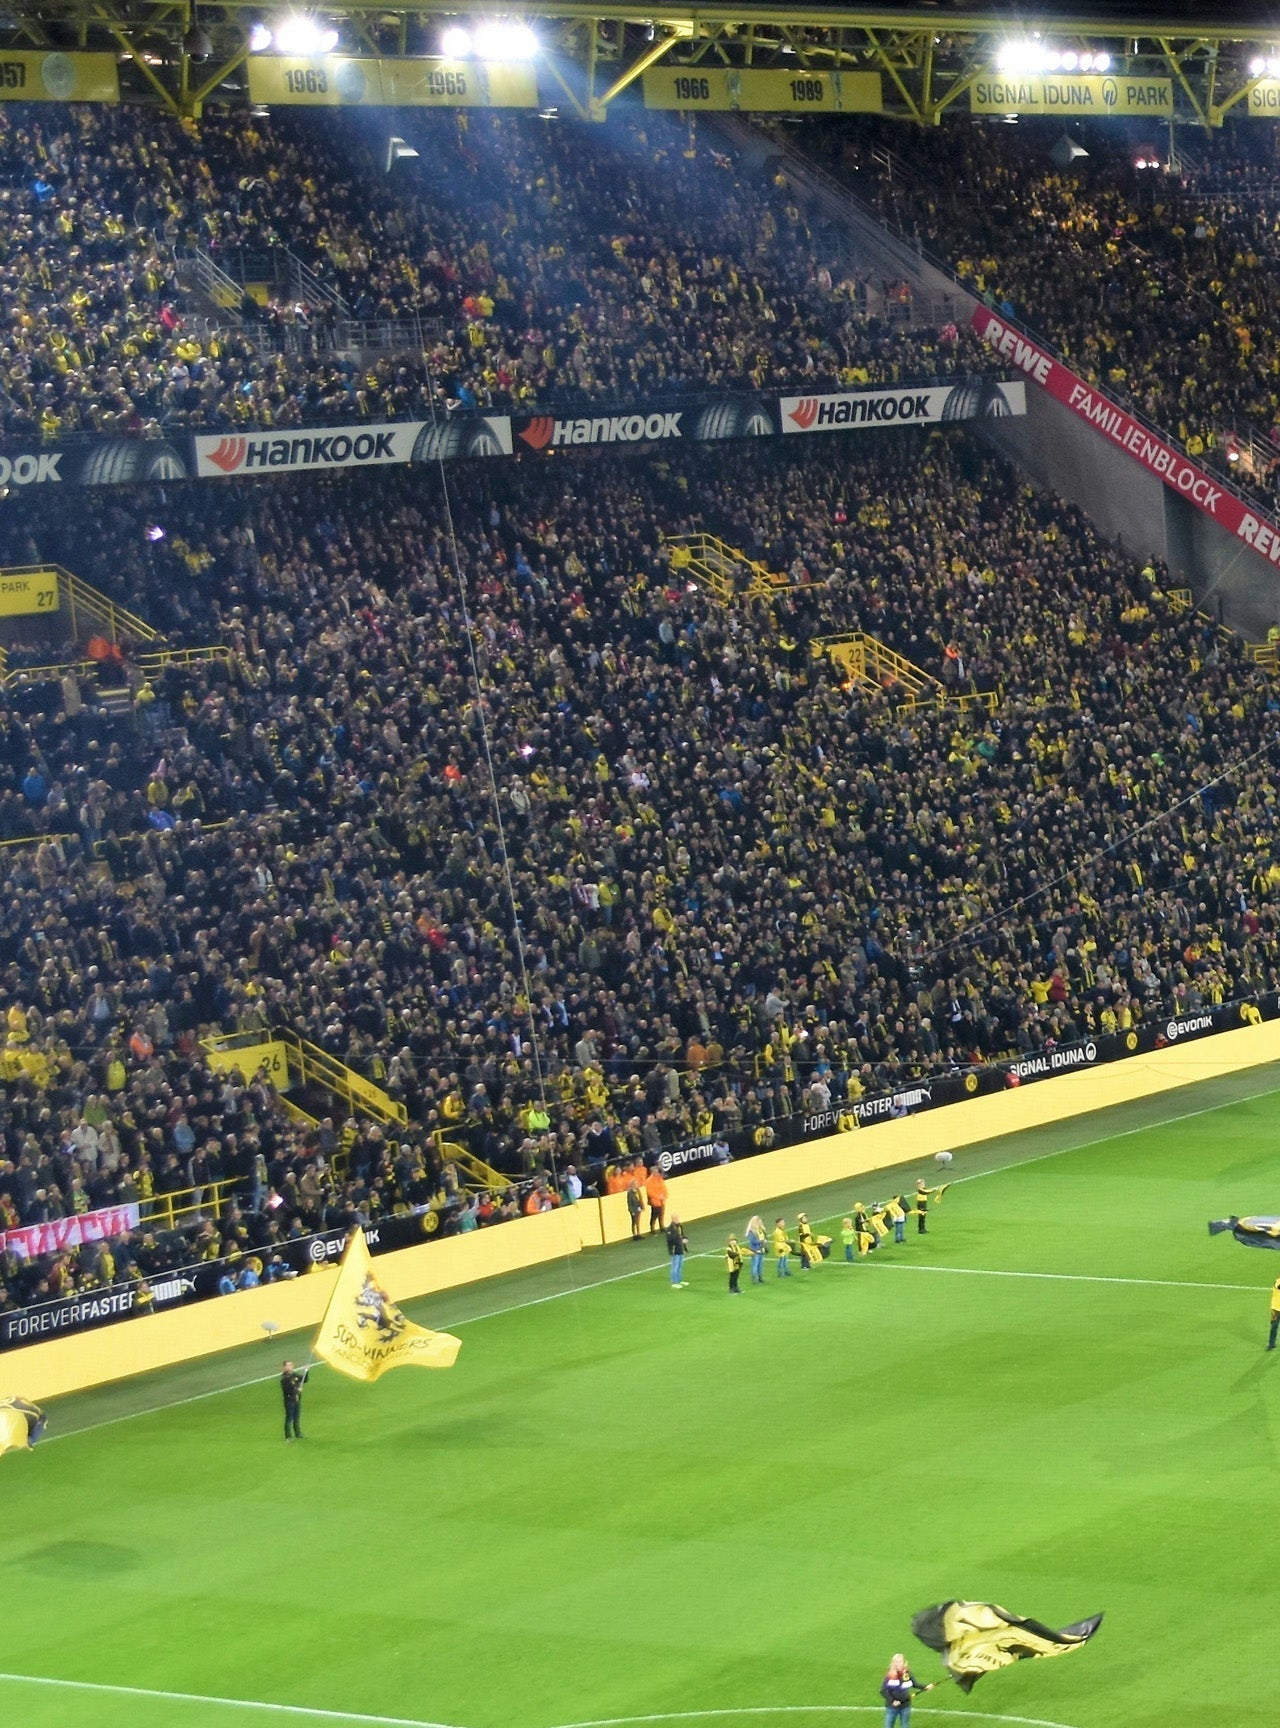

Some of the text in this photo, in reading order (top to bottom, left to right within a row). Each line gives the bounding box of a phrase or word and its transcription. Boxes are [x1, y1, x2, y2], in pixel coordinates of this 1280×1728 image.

[285, 69, 328, 94] 1963
[427, 71, 467, 95] 1965
[674, 78, 710, 100] 1966
[790, 79, 823, 102] 1989
[977, 83, 1170, 106] SIGNAL IDUNA PARK
[982, 318, 1054, 385] REWE
[1069, 384, 1223, 514] FAMILIENBLOCK
[2, 581, 30, 593] PARK
[37, 591, 54, 607] 27
[1178, 1015, 1213, 1034] EVONIK
[1010, 1047, 1085, 1076] SIGNAL IDUNA
[326, 1229, 380, 1255] EVIK
